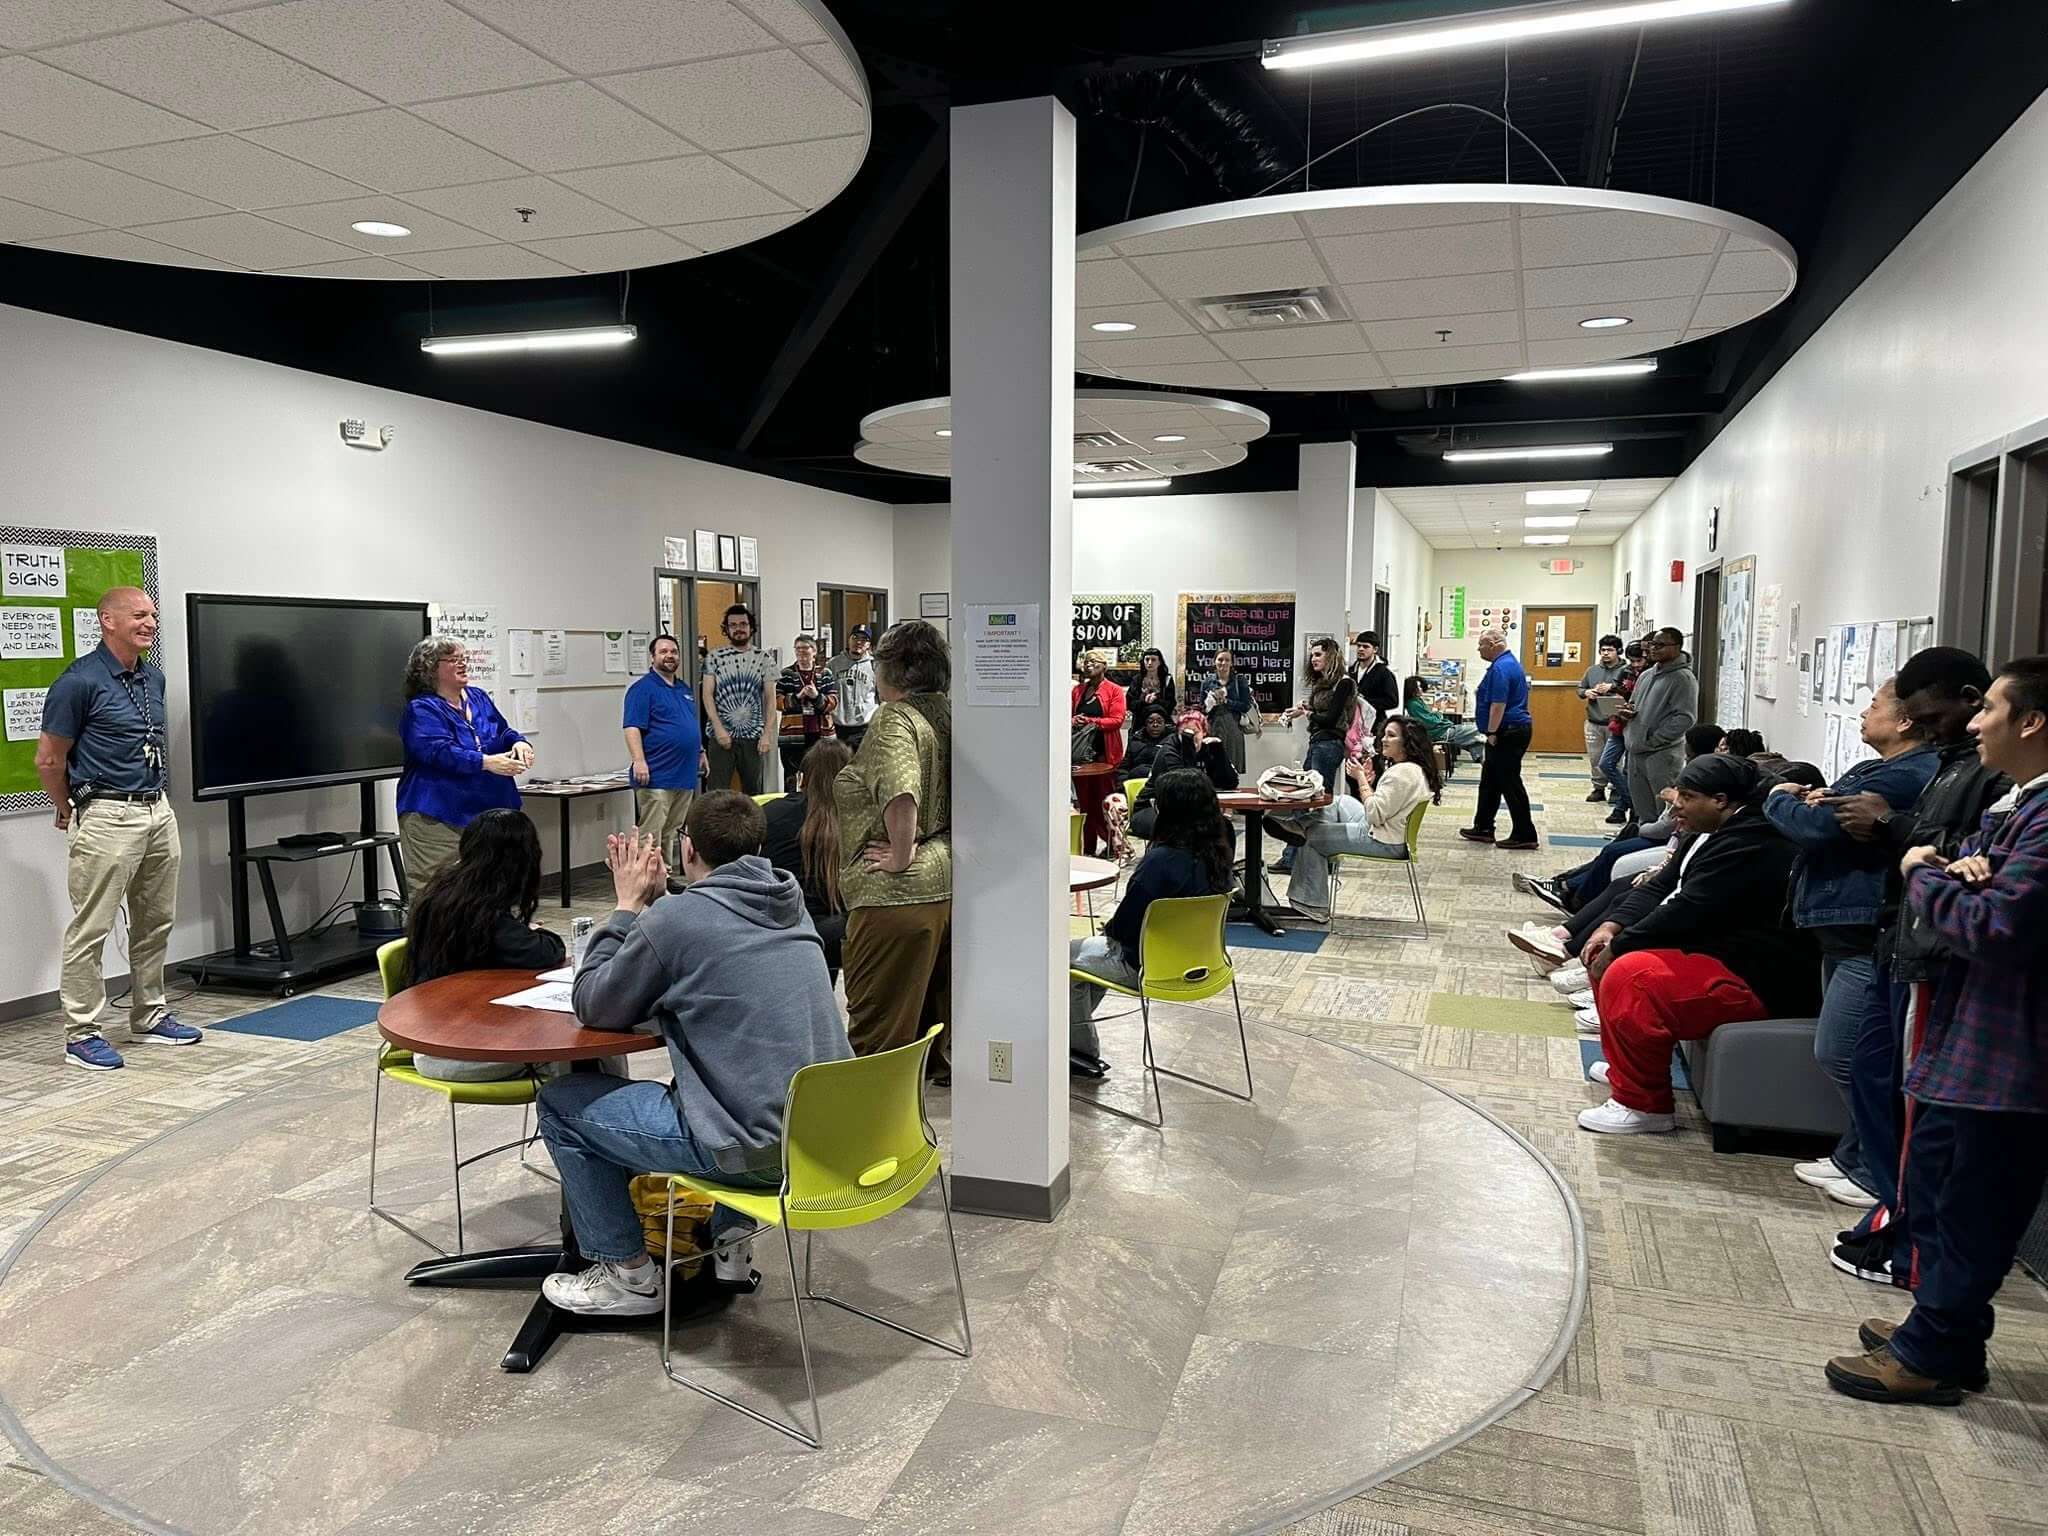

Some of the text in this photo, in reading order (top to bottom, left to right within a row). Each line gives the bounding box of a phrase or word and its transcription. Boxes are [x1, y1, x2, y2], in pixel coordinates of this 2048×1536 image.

[5, 553, 60, 568] TRUTH
[9, 572, 59, 587] SIGNS
[2, 612, 55, 620] EVERYONE
[1072, 605, 1135, 620] RDS OF
[1203, 606, 1290, 620] In case no one
[2, 622, 57, 631] NEEDS TIME
[1192, 623, 1214, 635] told
[1242, 623, 1277, 636] today
[9, 632, 52, 640] TO THINK
[2, 642, 58, 650] AND LEARN
[1195, 638, 1279, 653] Good Morning
[1233, 654, 1258, 668] long
[1262, 655, 1291, 668] here
[1255, 671, 1287, 685] great
